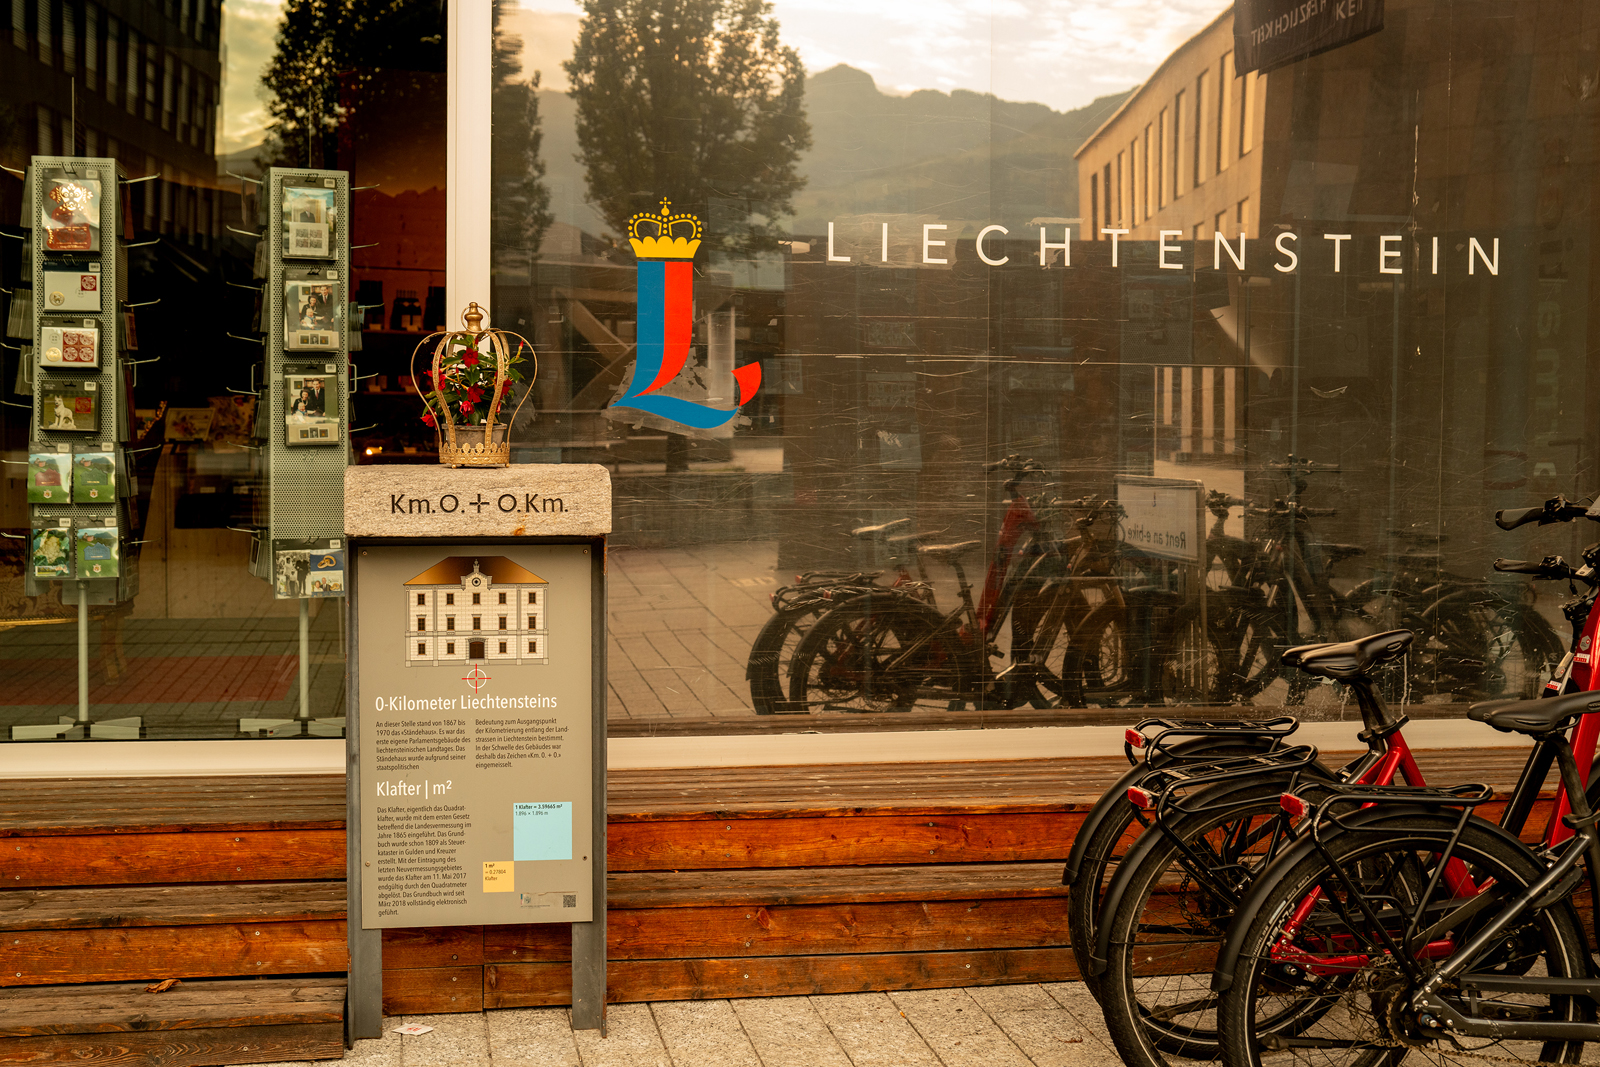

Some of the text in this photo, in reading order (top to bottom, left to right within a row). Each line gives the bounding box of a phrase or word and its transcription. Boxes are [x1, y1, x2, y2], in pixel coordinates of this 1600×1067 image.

[827, 221, 1500, 276] LIECHTENSTEIN
[376, 694, 557, 711] 0-Kilometer Liechtensteins
[376, 780, 421, 796] Klafter
[407, 806, 432, 814] eigentlich
